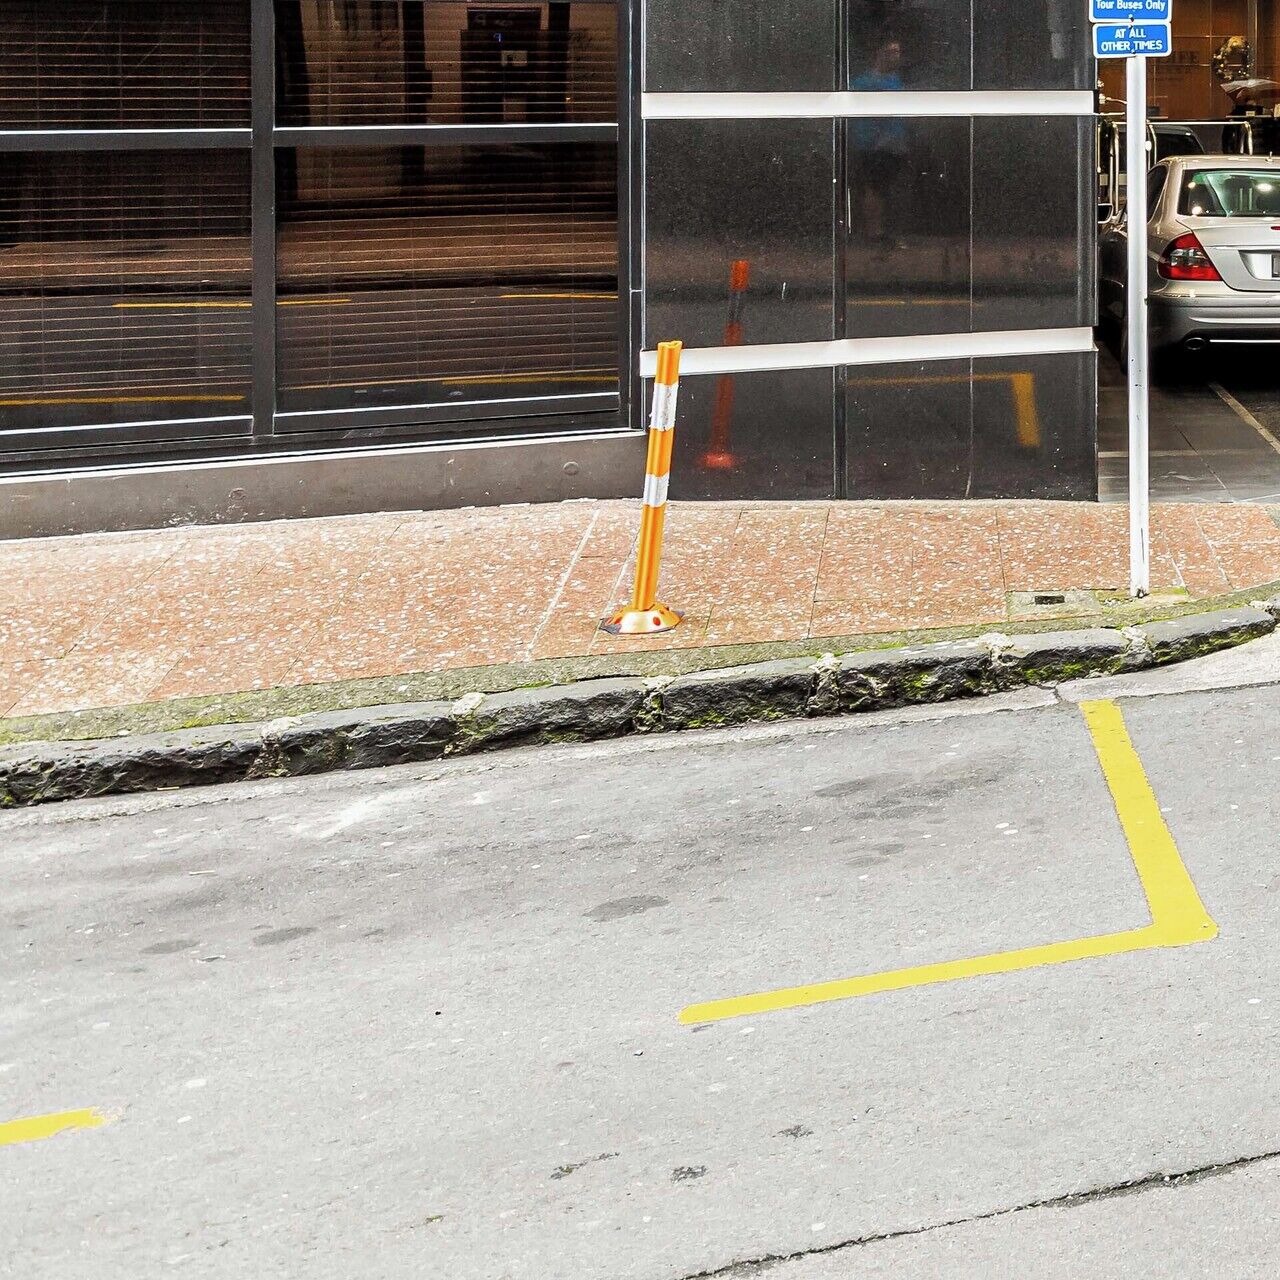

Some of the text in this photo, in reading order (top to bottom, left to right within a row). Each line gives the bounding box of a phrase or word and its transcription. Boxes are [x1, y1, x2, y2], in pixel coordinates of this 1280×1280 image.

[1096, 0, 1166, 12] Tour Buses Only
[1114, 27, 1147, 39] AT ALL
[1101, 40, 1163, 52] OTHER TIMES
